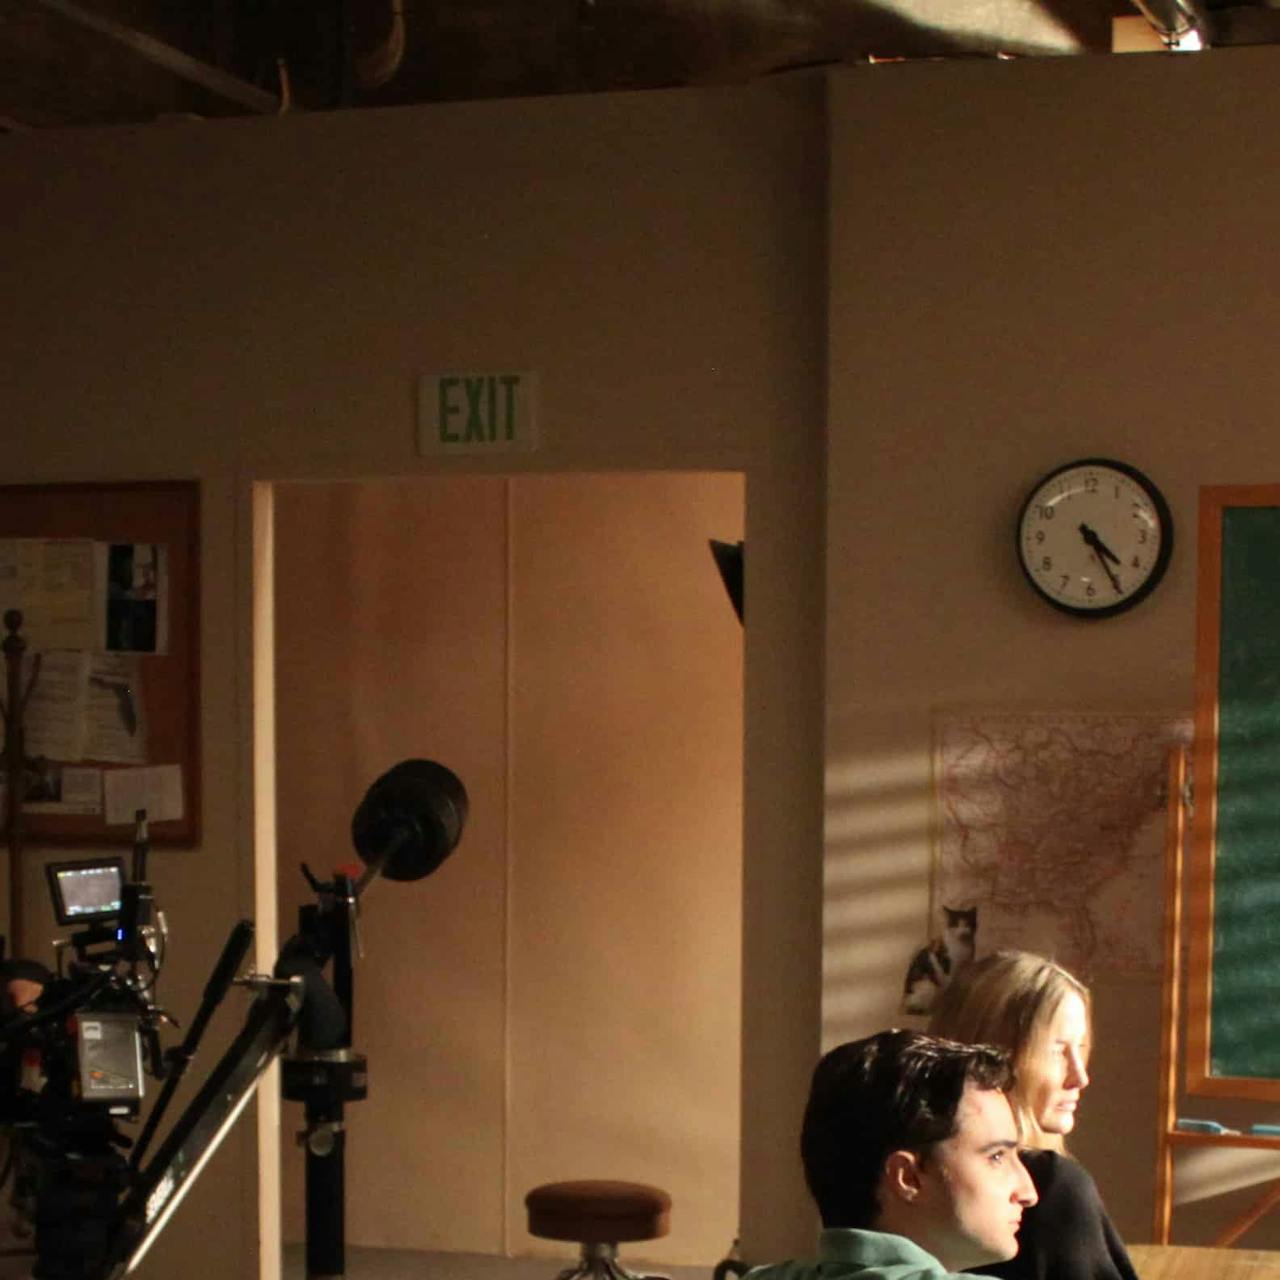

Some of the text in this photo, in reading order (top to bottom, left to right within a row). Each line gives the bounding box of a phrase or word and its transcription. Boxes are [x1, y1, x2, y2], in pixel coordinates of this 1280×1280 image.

[439, 376, 521, 443] EXIT
[1035, 504, 1055, 520] 10
[1036, 531, 1045, 545] 9
[1138, 529, 1147, 544] 3
[1042, 556, 1052, 572] 8
[1131, 556, 1141, 568] 4
[1060, 575, 1070, 590] 7
[1086, 583, 1096, 597] 6
